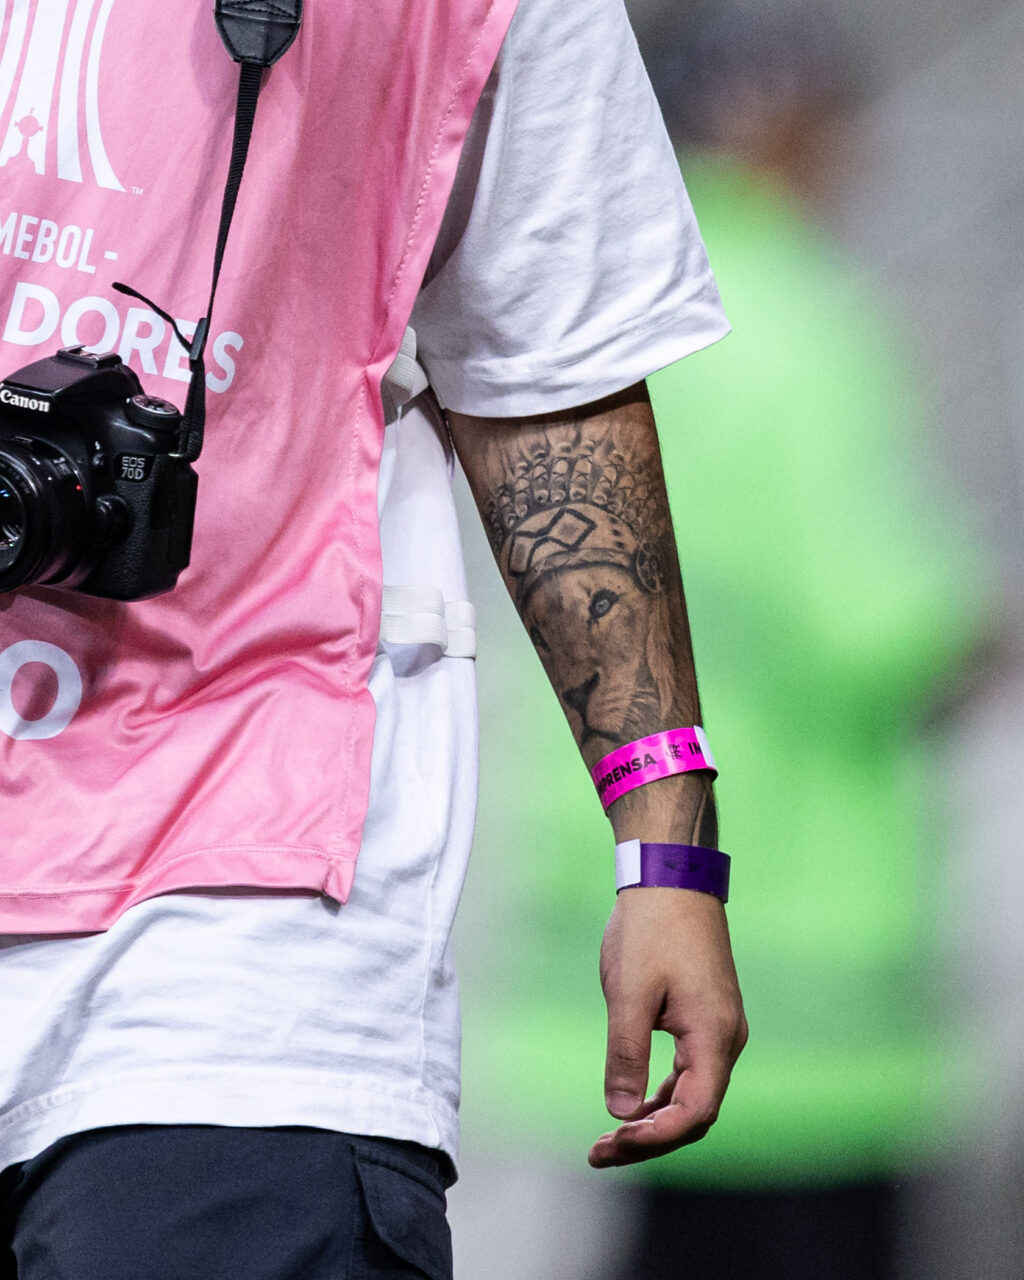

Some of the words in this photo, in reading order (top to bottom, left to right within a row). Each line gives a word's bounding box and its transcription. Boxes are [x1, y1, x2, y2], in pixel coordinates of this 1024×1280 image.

[0, 389, 50, 412] Canon
[121, 456, 146, 468] EOS
[121, 466, 144, 480] 70D
